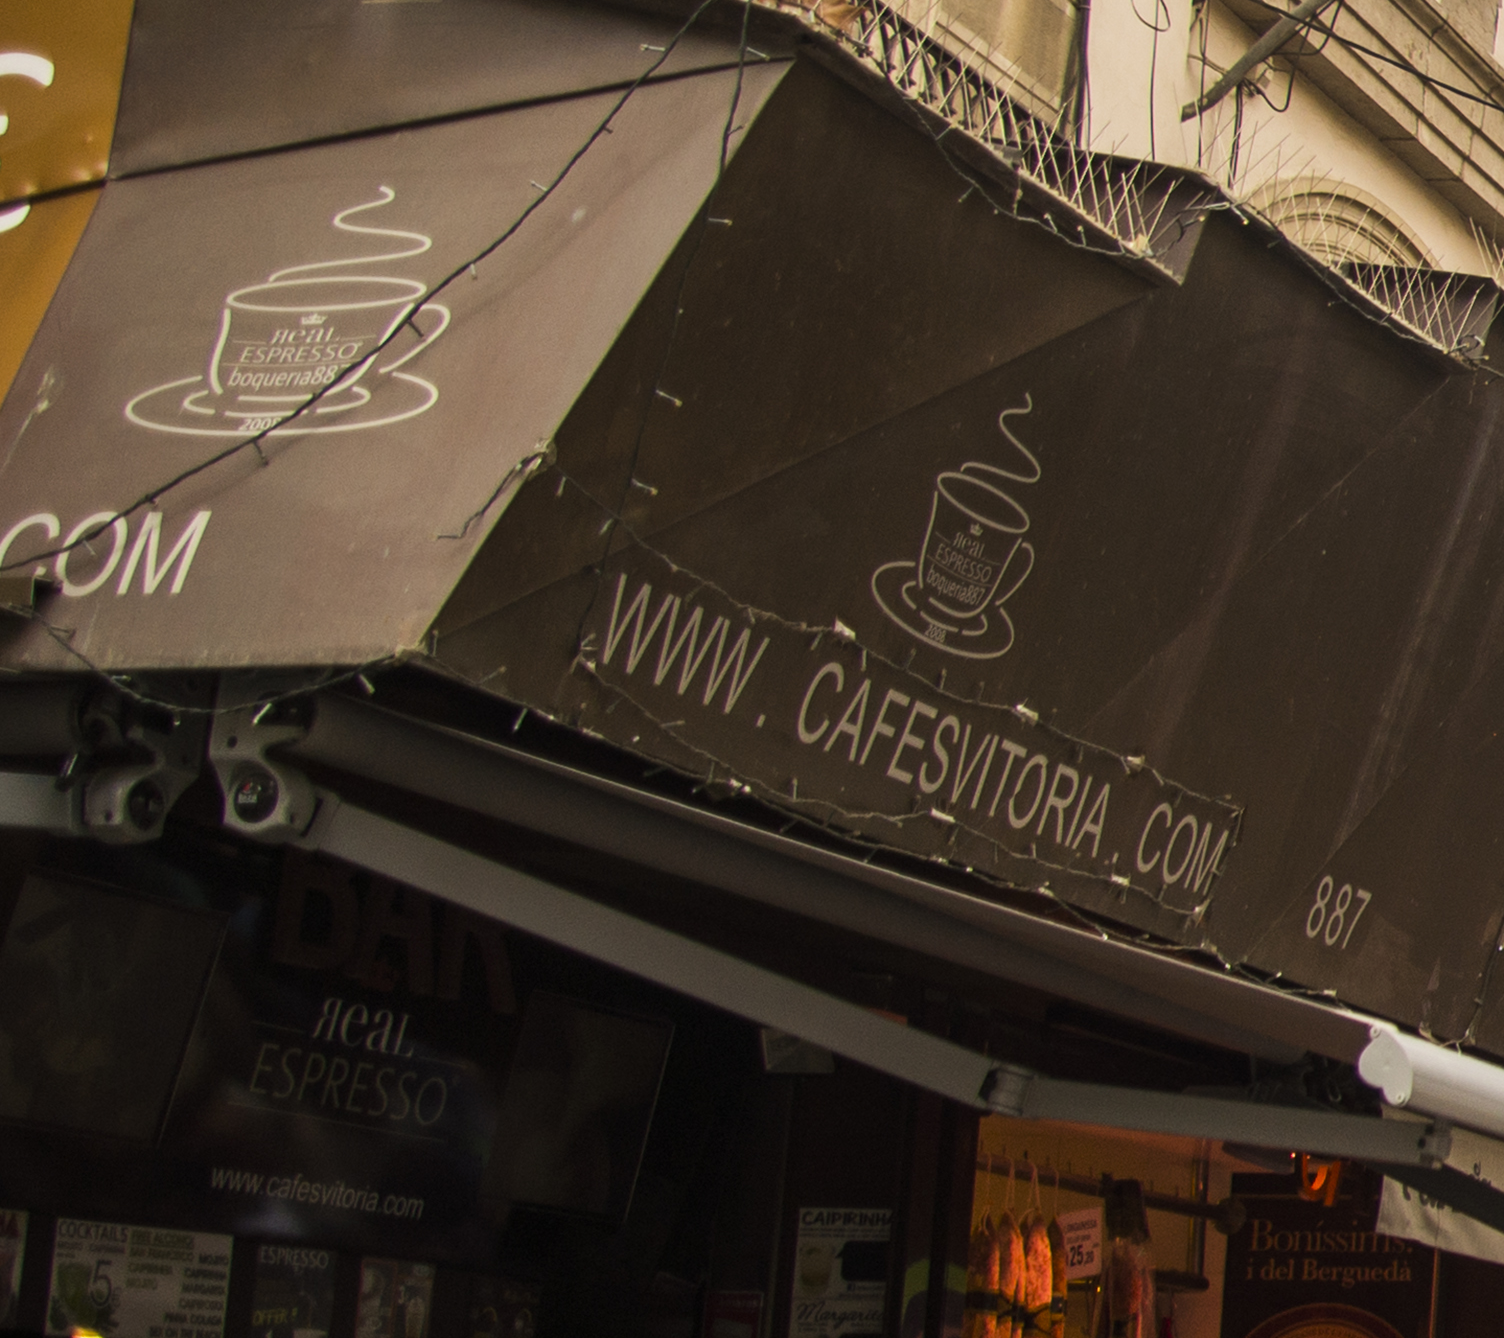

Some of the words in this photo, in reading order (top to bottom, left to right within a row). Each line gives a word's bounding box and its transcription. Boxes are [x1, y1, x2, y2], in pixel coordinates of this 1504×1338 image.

[239, 342, 359, 364] ESPRESSO
[935, 543, 993, 583] ESPRESSO
[926, 563, 986, 606] boqueria887
[1305, 874, 1373, 950] 887
[249, 1041, 449, 1128] ESPRESSO
[211, 1166, 426, 1221] www.cafesvitoria.com
[57, 1218, 129, 1243] COCKTAILS
[258, 1244, 330, 1270] ESPRESSO
[1260, 1258, 1295, 1281] del
[1301, 1257, 1413, 1288] Berguedà
